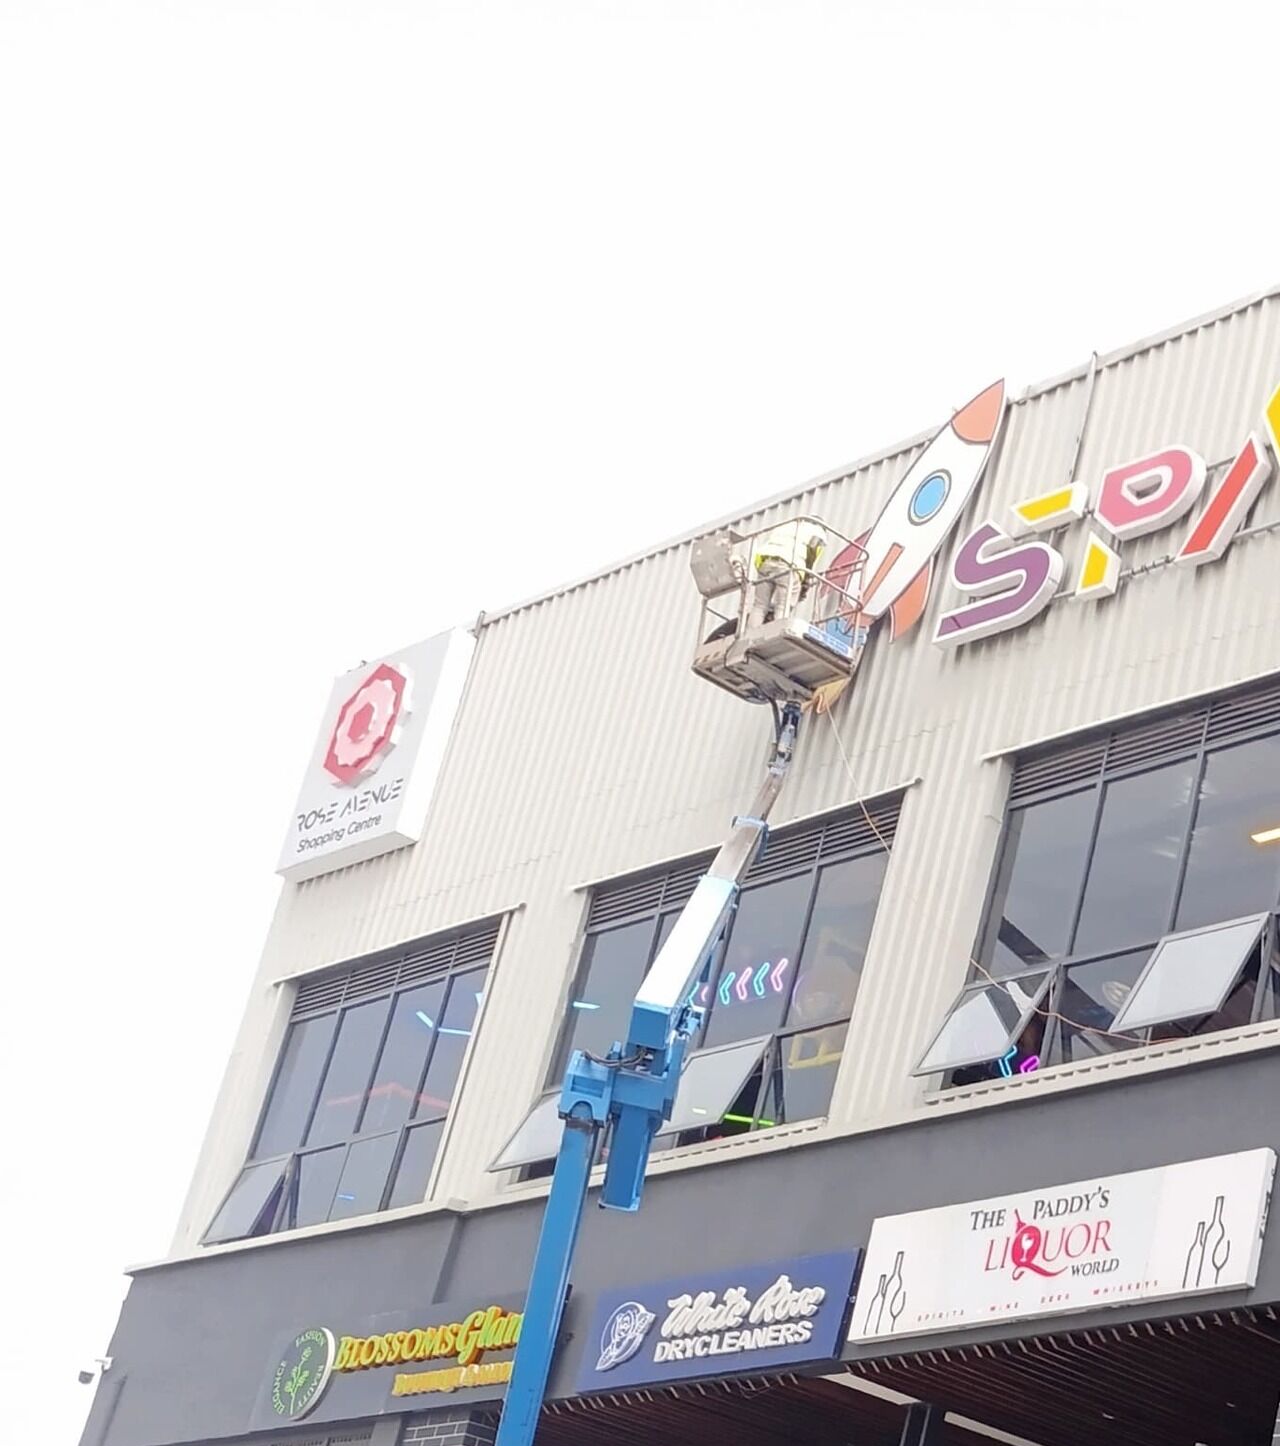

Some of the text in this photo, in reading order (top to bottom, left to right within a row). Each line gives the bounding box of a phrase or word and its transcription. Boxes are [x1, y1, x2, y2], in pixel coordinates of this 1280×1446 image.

[297, 813, 382, 853] Shopping Centre
[970, 1186, 1111, 1231] THE PADDY'S
[984, 1217, 1112, 1281] LIQUOR
[1070, 1258, 1120, 1277] WORLD
[661, 1286, 751, 1338] White
[653, 1320, 814, 1363] DRYCLEANERS
